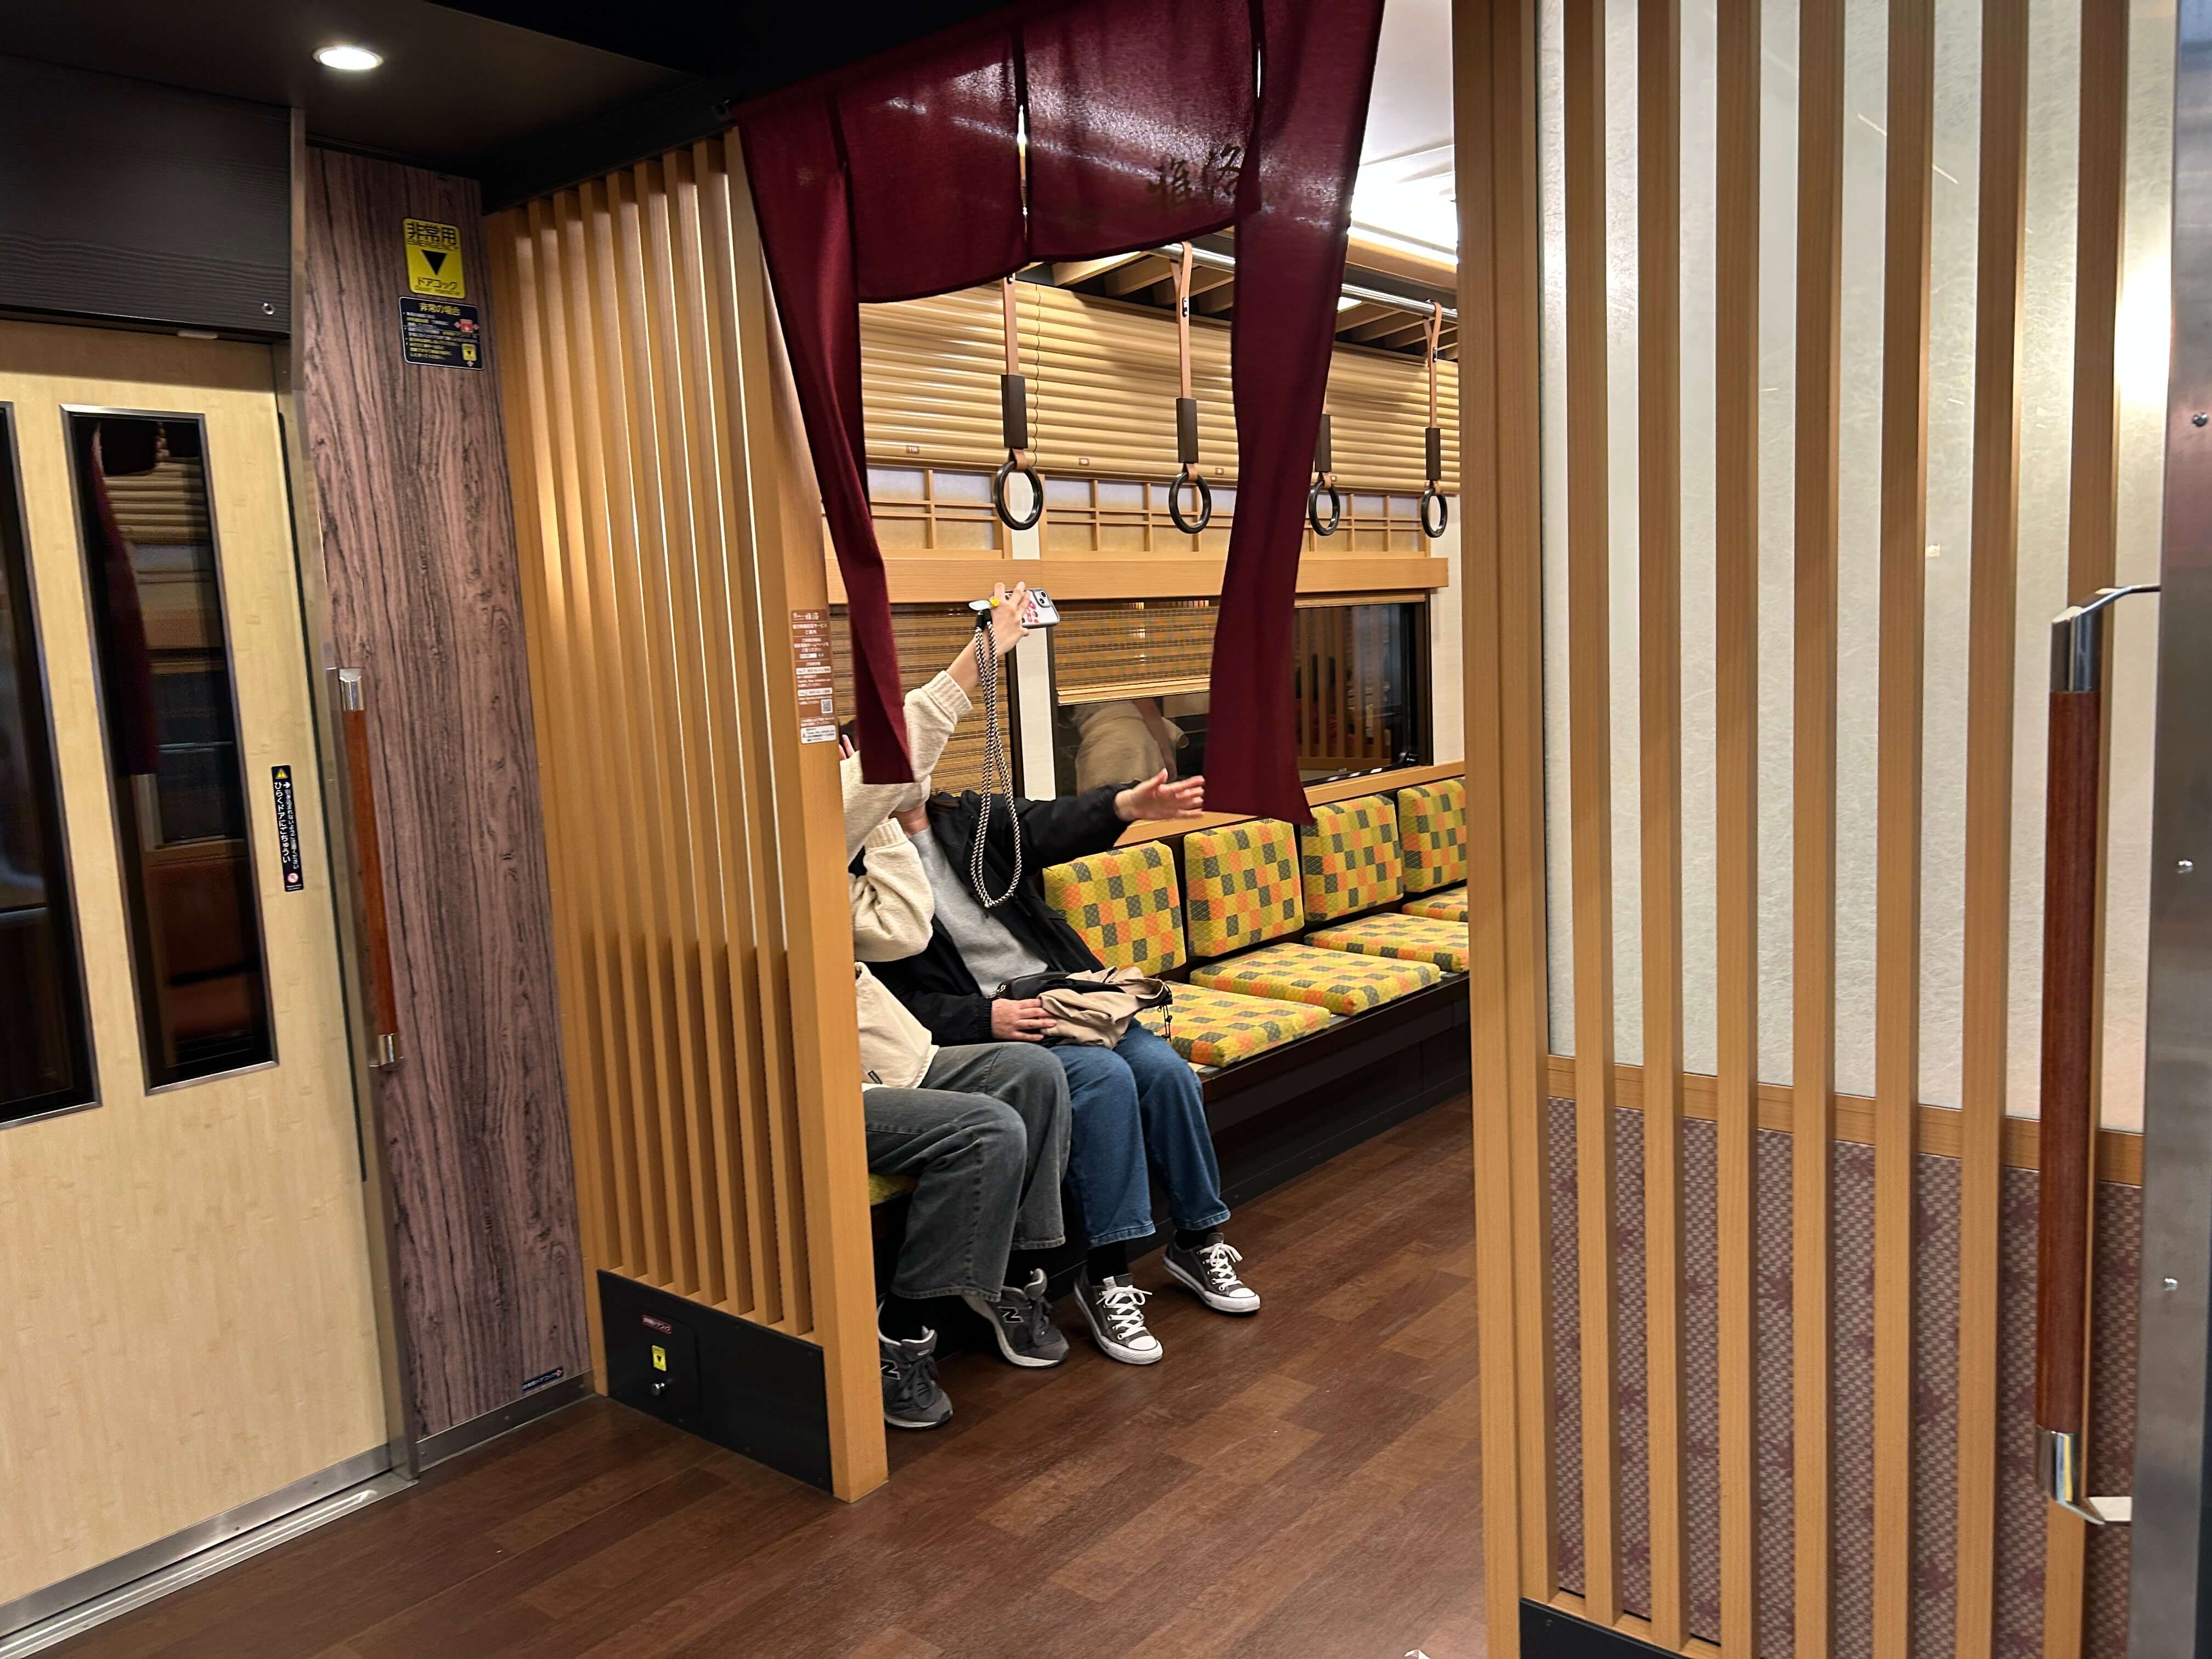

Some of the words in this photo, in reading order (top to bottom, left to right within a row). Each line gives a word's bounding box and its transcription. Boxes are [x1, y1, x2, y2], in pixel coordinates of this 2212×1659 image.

[407, 222, 456, 245] 非常用
[417, 276, 457, 290] ドアコック
[274, 782, 291, 863] ひらくドアにごちゅうい
